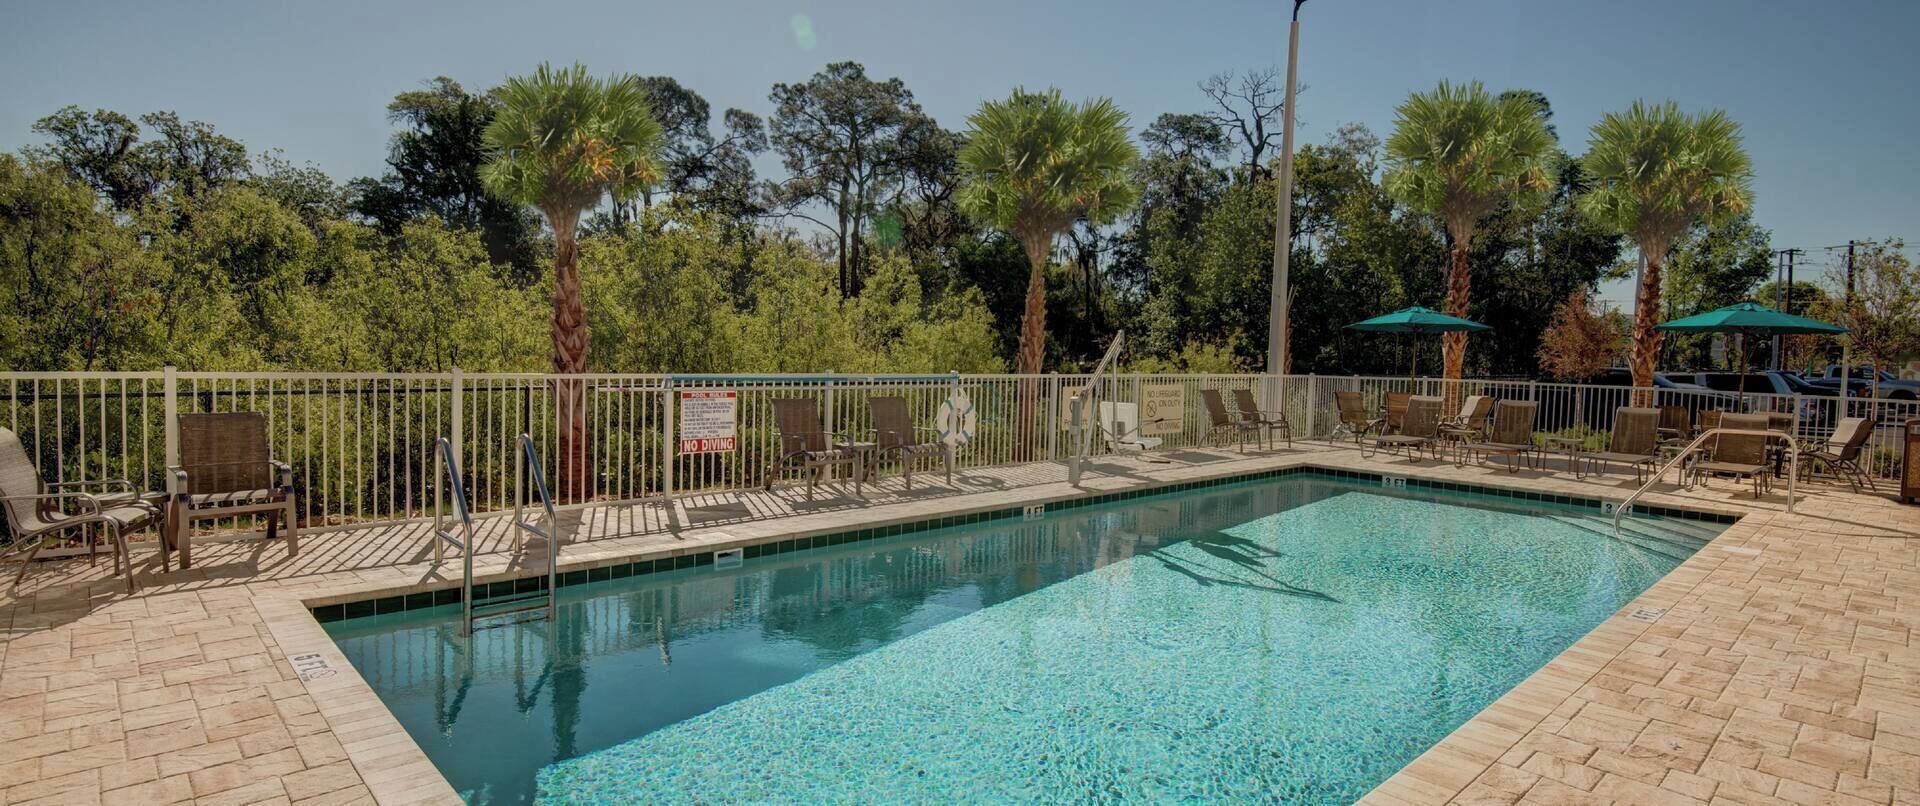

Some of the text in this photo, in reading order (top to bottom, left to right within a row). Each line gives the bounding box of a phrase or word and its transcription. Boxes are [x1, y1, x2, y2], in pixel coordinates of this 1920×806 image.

[1147, 390, 1155, 398] NO
[1158, 399, 1181, 407] ON DUTY
[1156, 422, 1163, 430] NO
[684, 438, 734, 452] NO DIVING
[1385, 477, 1405, 487] 3 FT
[1034, 505, 1044, 514] FT
[1605, 503, 1613, 513] 3
[296, 659, 329, 672] FT
